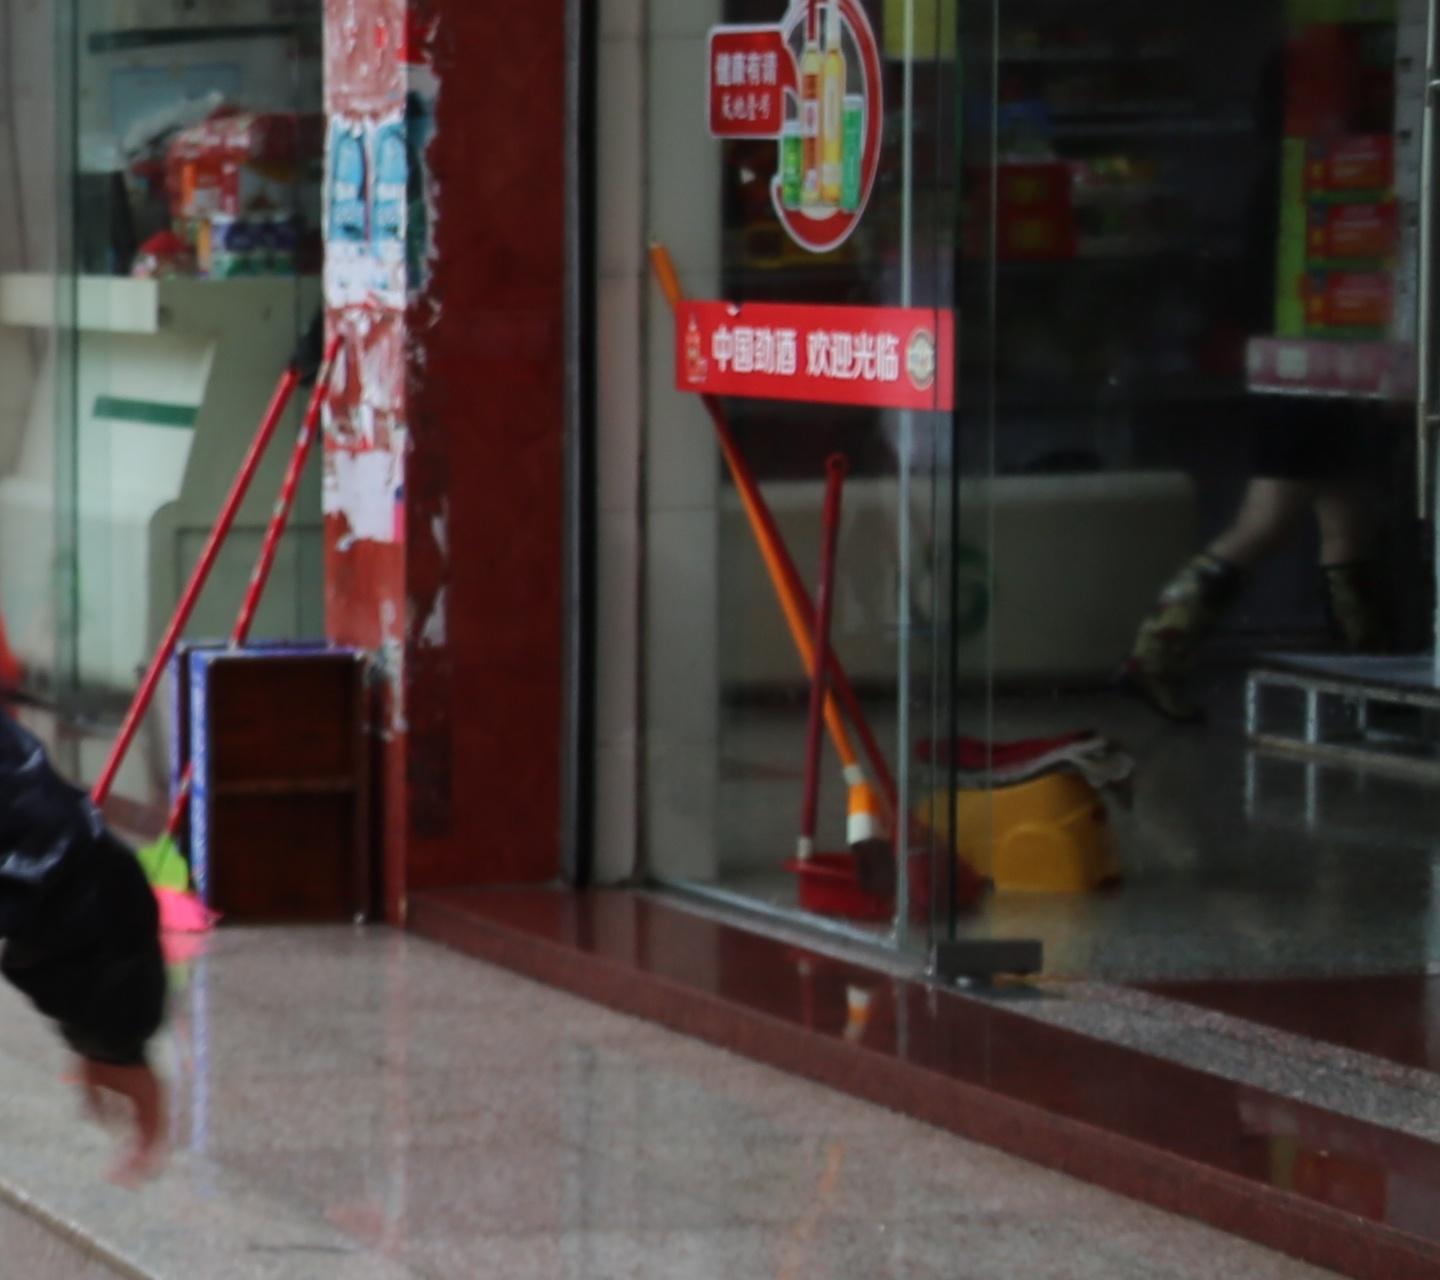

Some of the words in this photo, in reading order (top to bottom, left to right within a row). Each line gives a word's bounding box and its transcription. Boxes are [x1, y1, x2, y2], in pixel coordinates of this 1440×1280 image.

[711, 324, 798, 376] 中国劲酒
[805, 329, 901, 383] 欢迎光临
